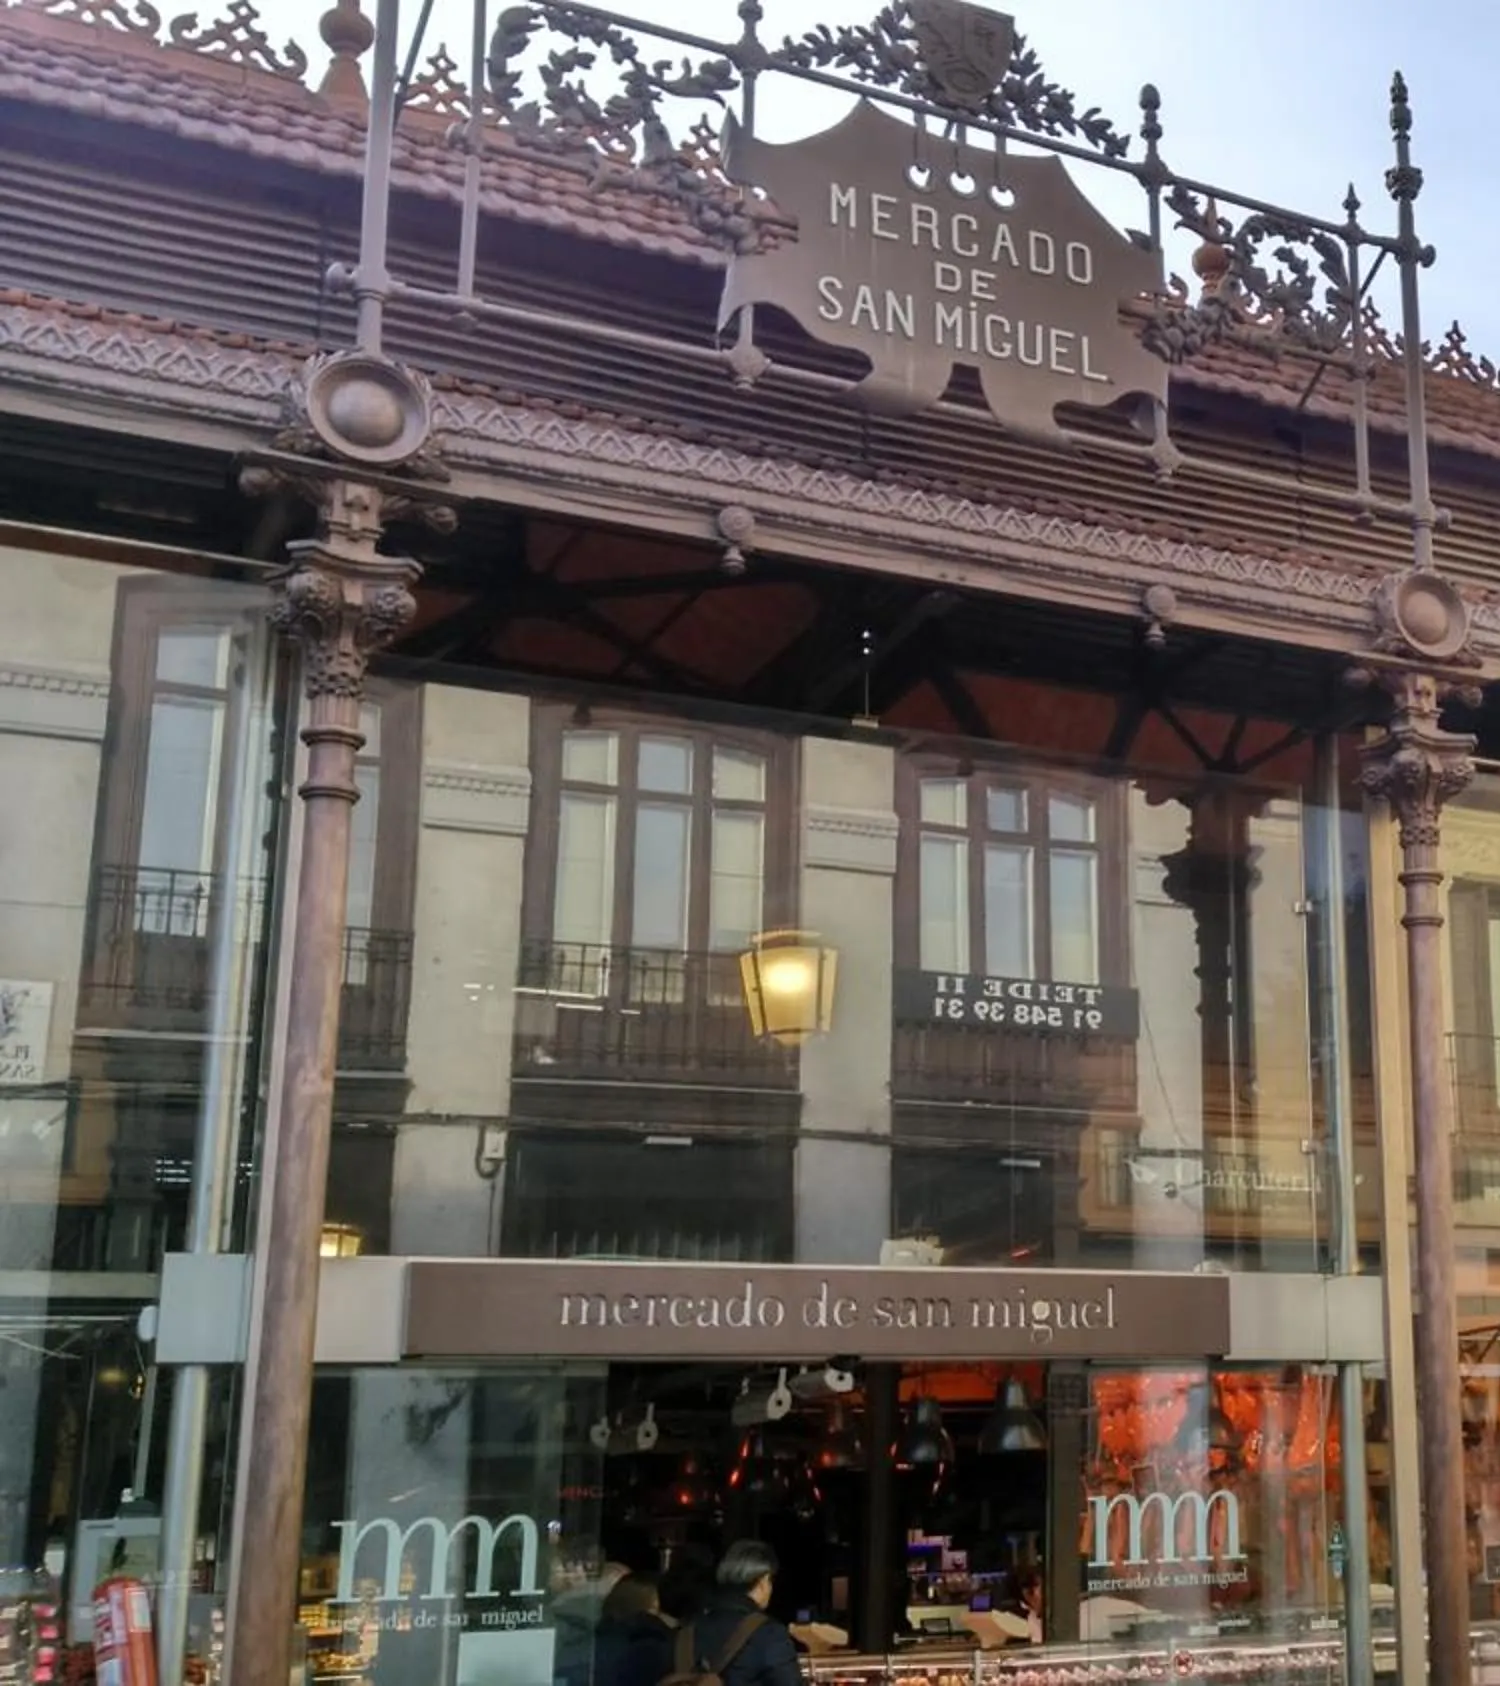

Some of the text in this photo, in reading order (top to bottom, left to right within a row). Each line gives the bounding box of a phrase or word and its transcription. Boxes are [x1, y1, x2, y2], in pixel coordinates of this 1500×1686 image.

[830, 182, 1094, 285] MERCADO
[934, 261, 998, 300] DE
[817, 275, 915, 339] SAN
[559, 1280, 1118, 1345] mercado de san miguel
[1087, 1566, 1249, 1592] mercado de san miguel
[413, 1609, 438, 1629] de
[481, 1604, 544, 1631] miguel
